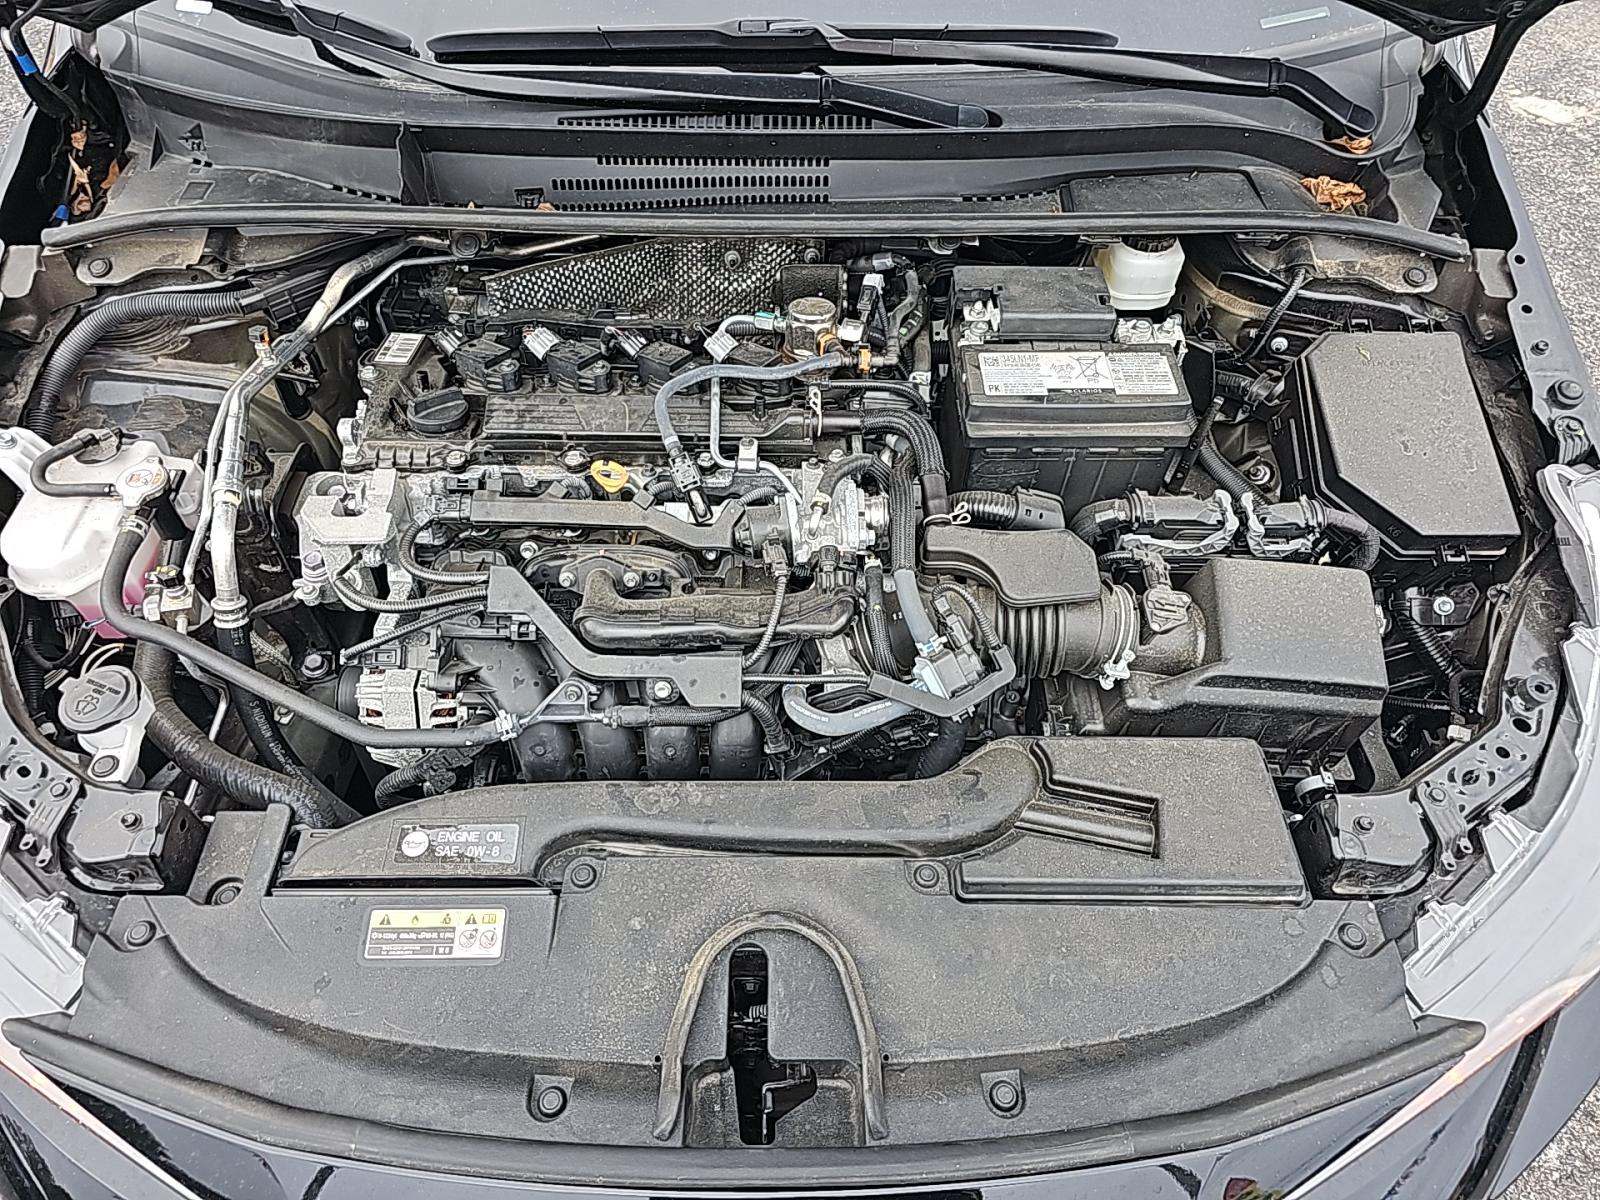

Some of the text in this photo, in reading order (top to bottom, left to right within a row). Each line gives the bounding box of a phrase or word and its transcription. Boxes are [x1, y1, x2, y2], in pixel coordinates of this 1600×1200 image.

[988, 384, 1000, 393] PK
[437, 830, 506, 843] ENGINE OIL
[434, 844, 500, 858] SAE 0W-8
